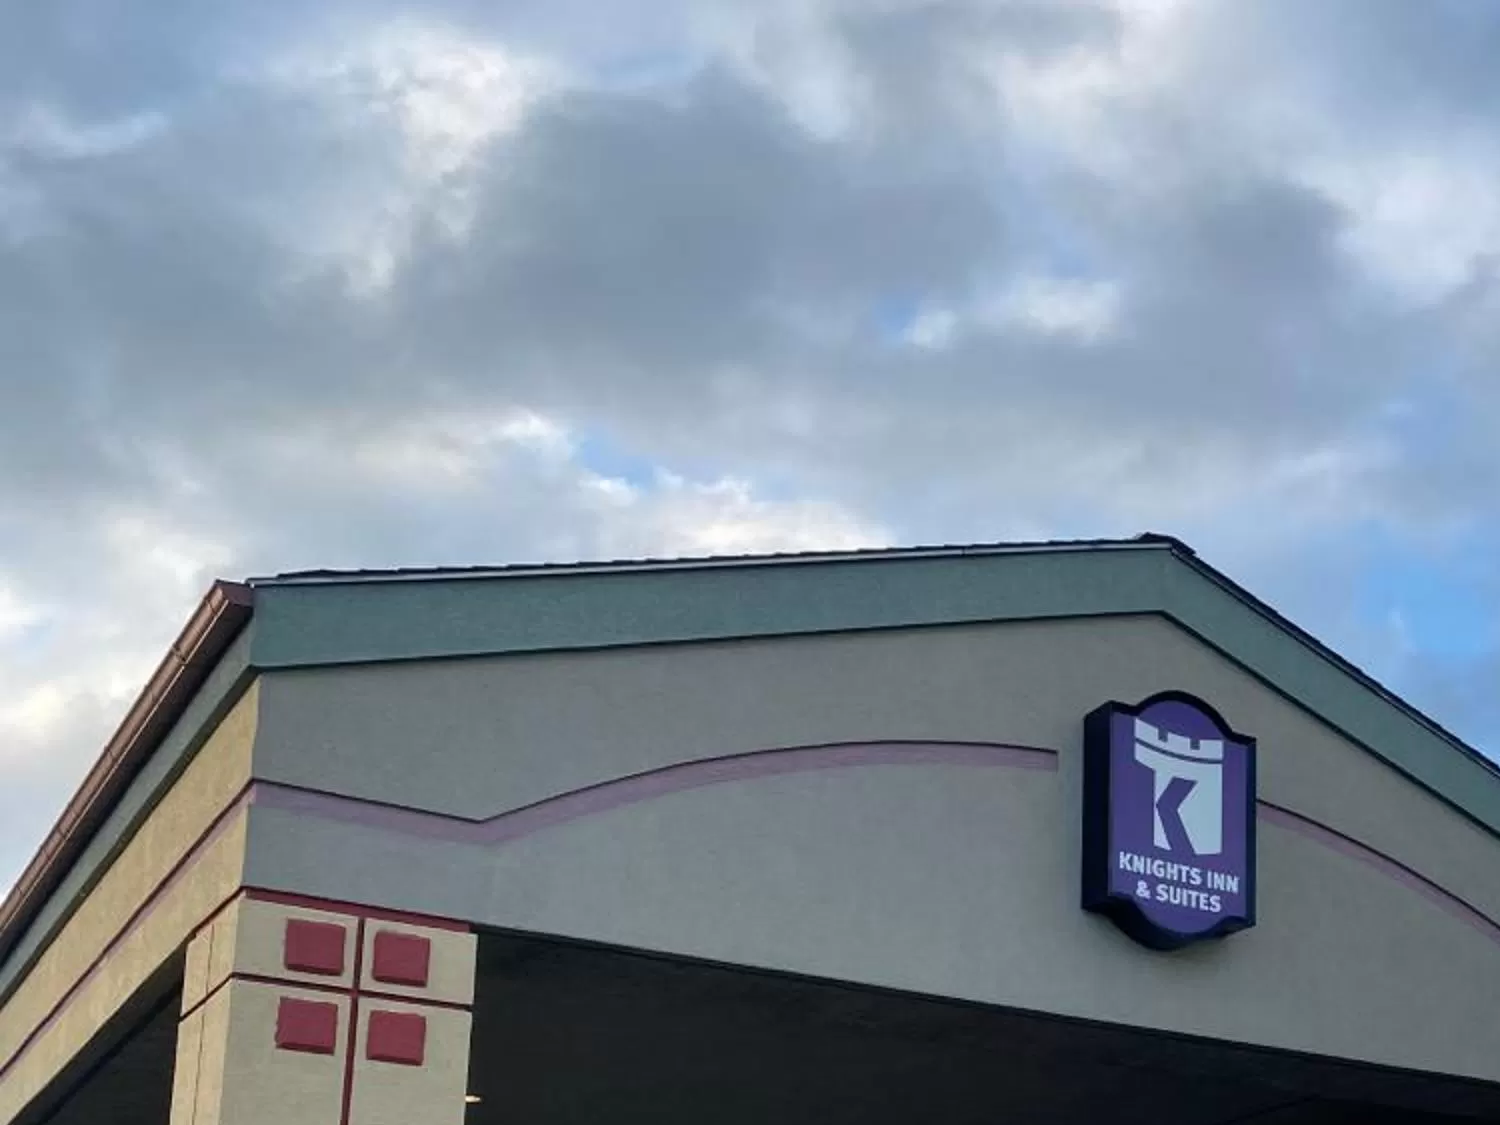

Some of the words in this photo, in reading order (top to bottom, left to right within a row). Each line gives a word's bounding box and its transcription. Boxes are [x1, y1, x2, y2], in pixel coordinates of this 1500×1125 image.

[1119, 851, 1202, 885] KNIGHTS
[1207, 870, 1239, 893] INN
[1135, 880, 1151, 899] &
[1156, 884, 1222, 912] SUITES
